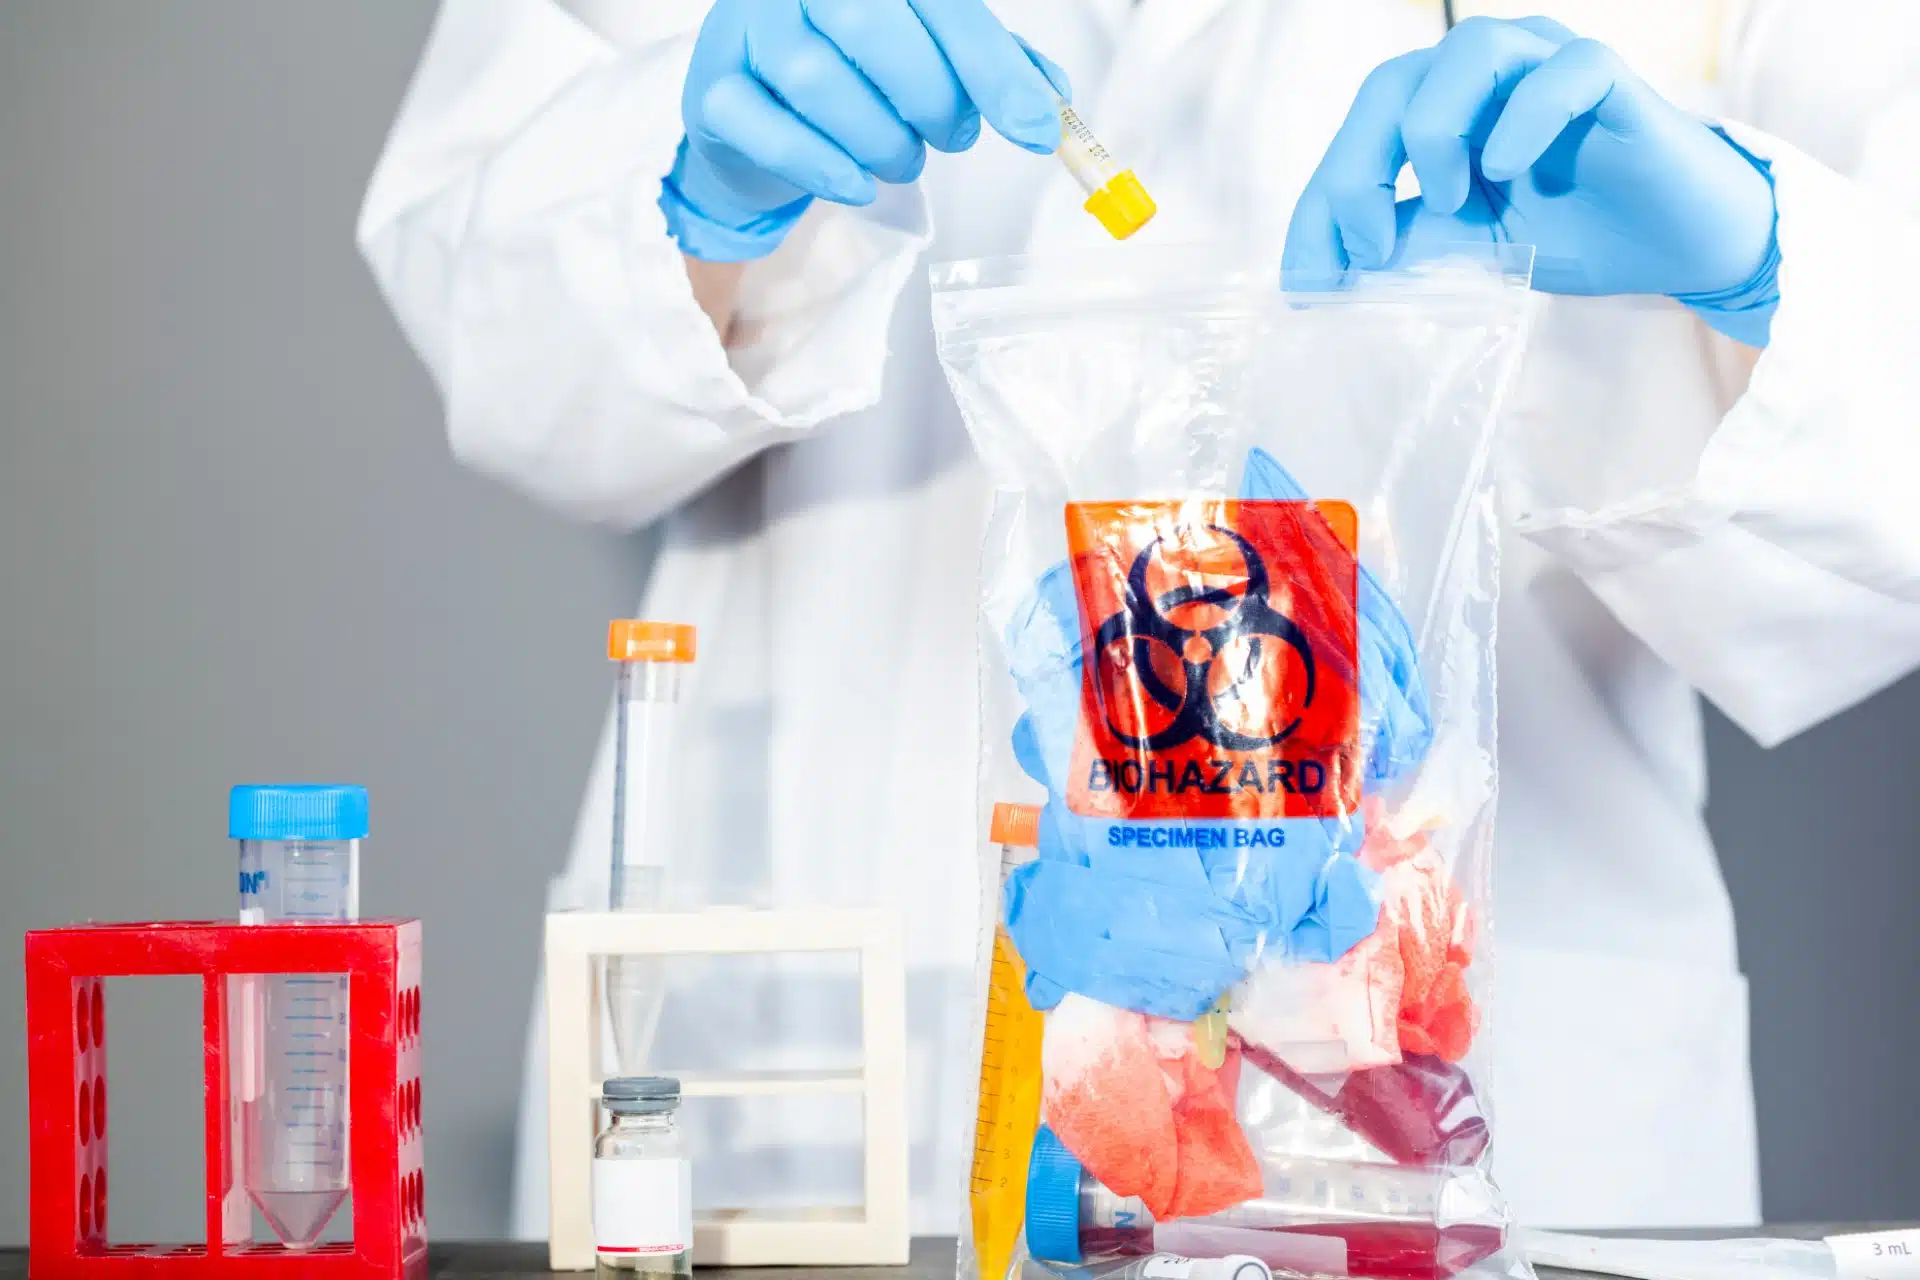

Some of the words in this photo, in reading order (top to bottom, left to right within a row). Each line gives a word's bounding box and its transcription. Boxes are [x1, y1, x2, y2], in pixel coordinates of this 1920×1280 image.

[1087, 758, 1327, 794] BIOHAZARD
[1107, 826, 1227, 848] SPECIMEN
[1233, 828, 1285, 848] BAG
[1871, 1241, 1883, 1256] 3
[1887, 1241, 1912, 1256] mL
